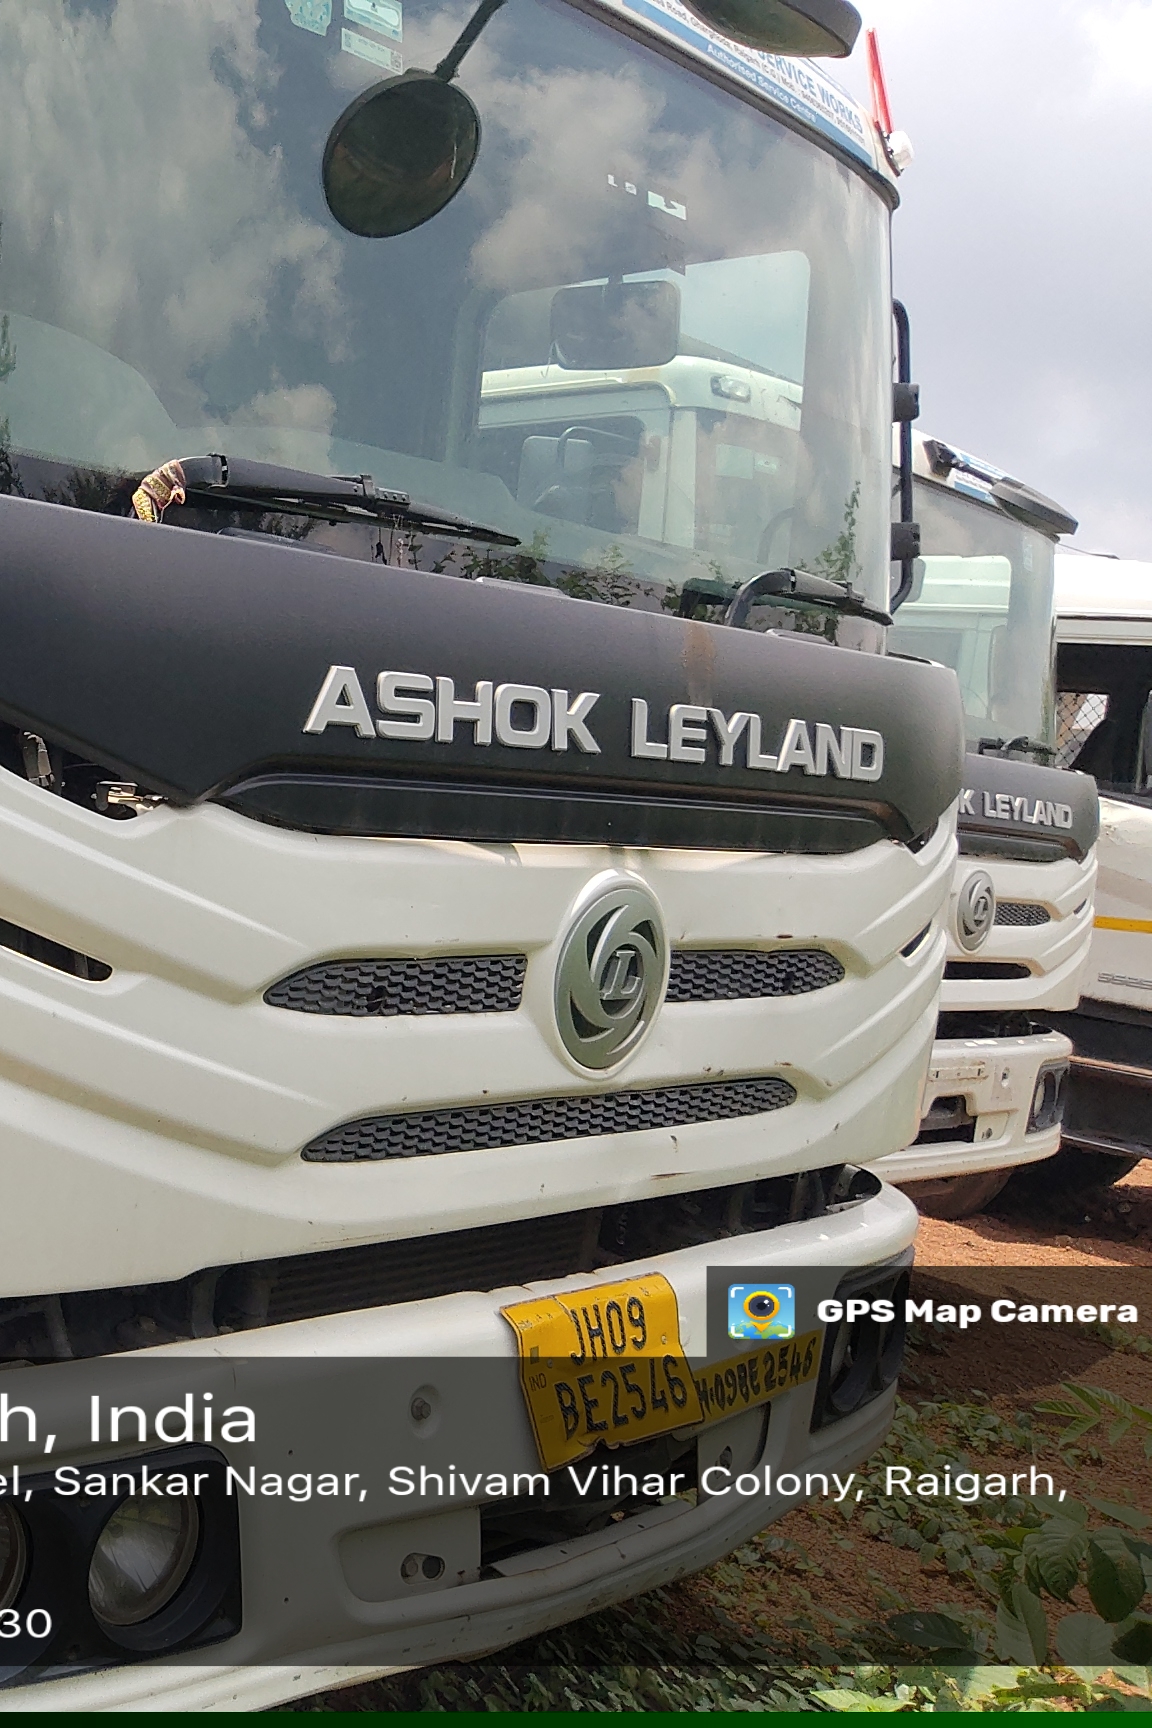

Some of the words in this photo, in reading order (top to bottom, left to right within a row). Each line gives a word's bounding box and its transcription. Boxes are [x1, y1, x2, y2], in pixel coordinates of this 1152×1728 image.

[817, 82, 864, 134] WORKS
[302, 664, 602, 755] ASHOK
[631, 696, 884, 783] LEYLAND
[983, 791, 1074, 829] LEYLAND
[569, 1296, 647, 1367] JH09
[529, 1372, 547, 1393] IND
[761, 1337, 817, 1393] 2546
[554, 1353, 688, 1440] BE2546
